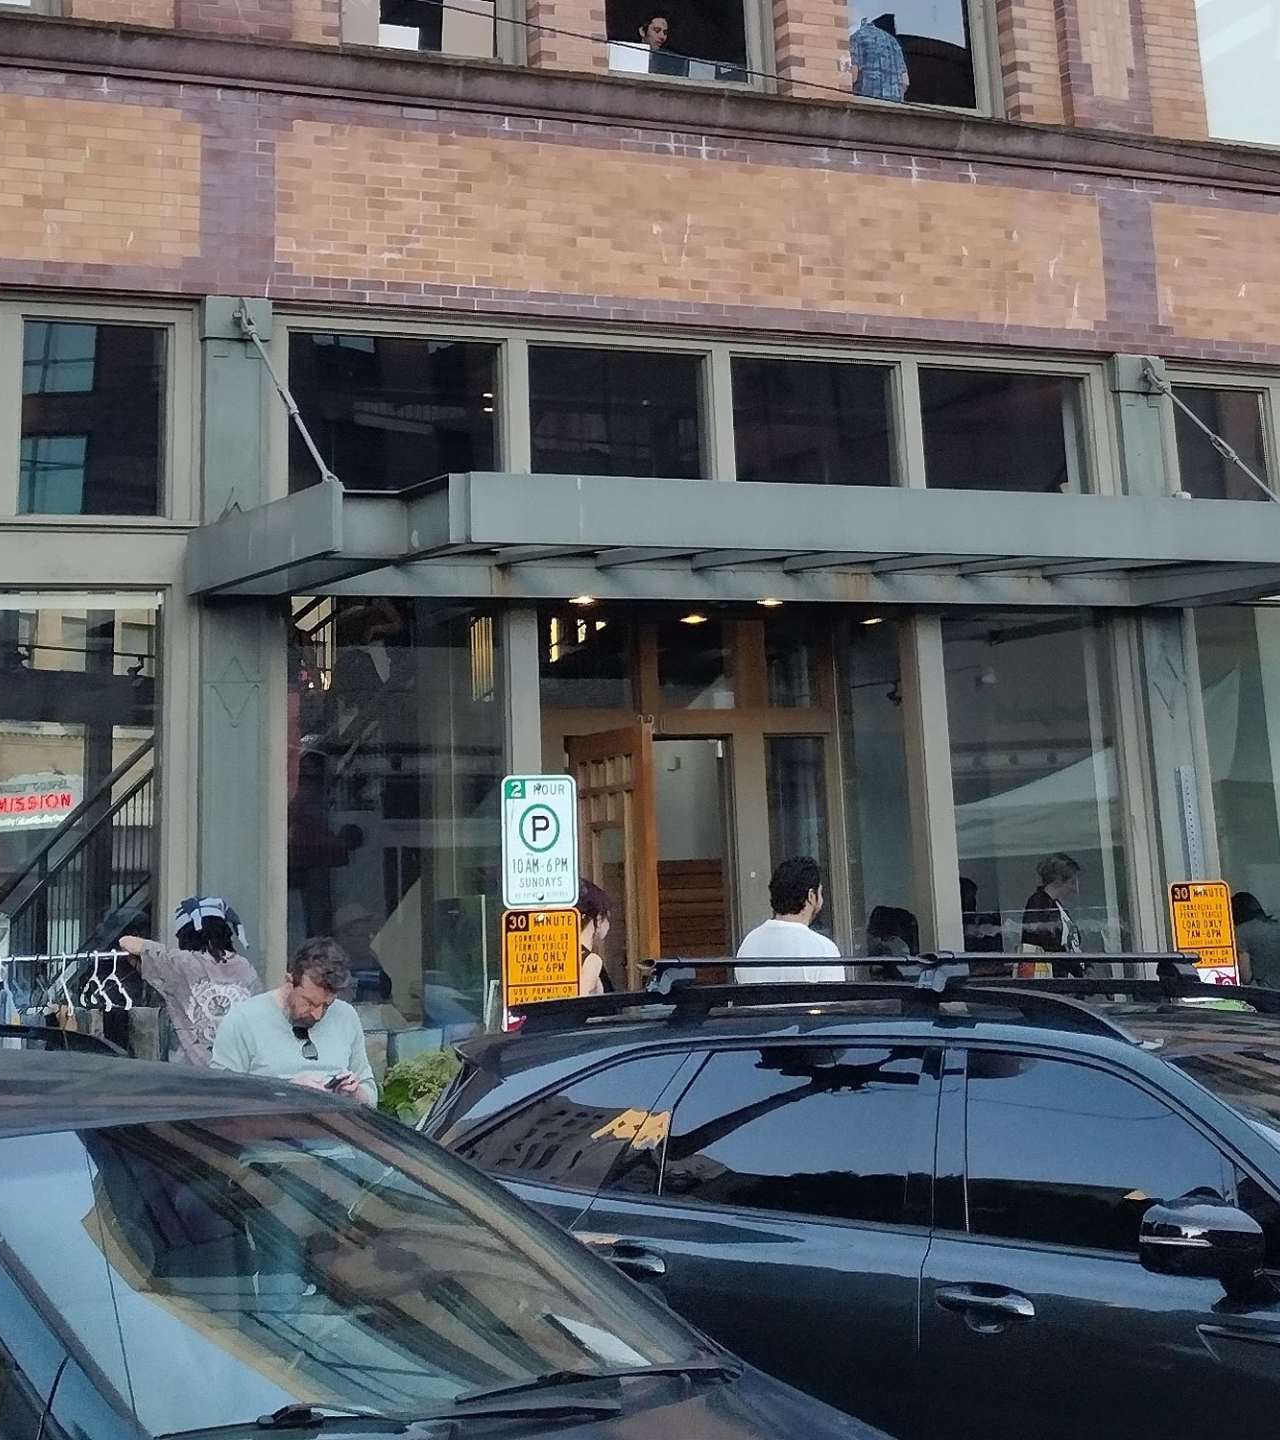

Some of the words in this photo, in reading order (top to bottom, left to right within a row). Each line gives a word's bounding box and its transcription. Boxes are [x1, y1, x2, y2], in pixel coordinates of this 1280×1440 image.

[510, 781, 522, 798] 2
[533, 783, 565, 796] HOUR
[532, 815, 550, 842] P
[520, 877, 563, 888] SUNDAYS
[1175, 888, 1188, 899] 30
[509, 915, 527, 929] 30
[533, 915, 572, 927] MINUTE
[1183, 920, 1201, 929] LOAD
[1204, 919, 1223, 928] ONLY
[516, 952, 539, 964] LOAD
[543, 951, 568, 962] ONLY
